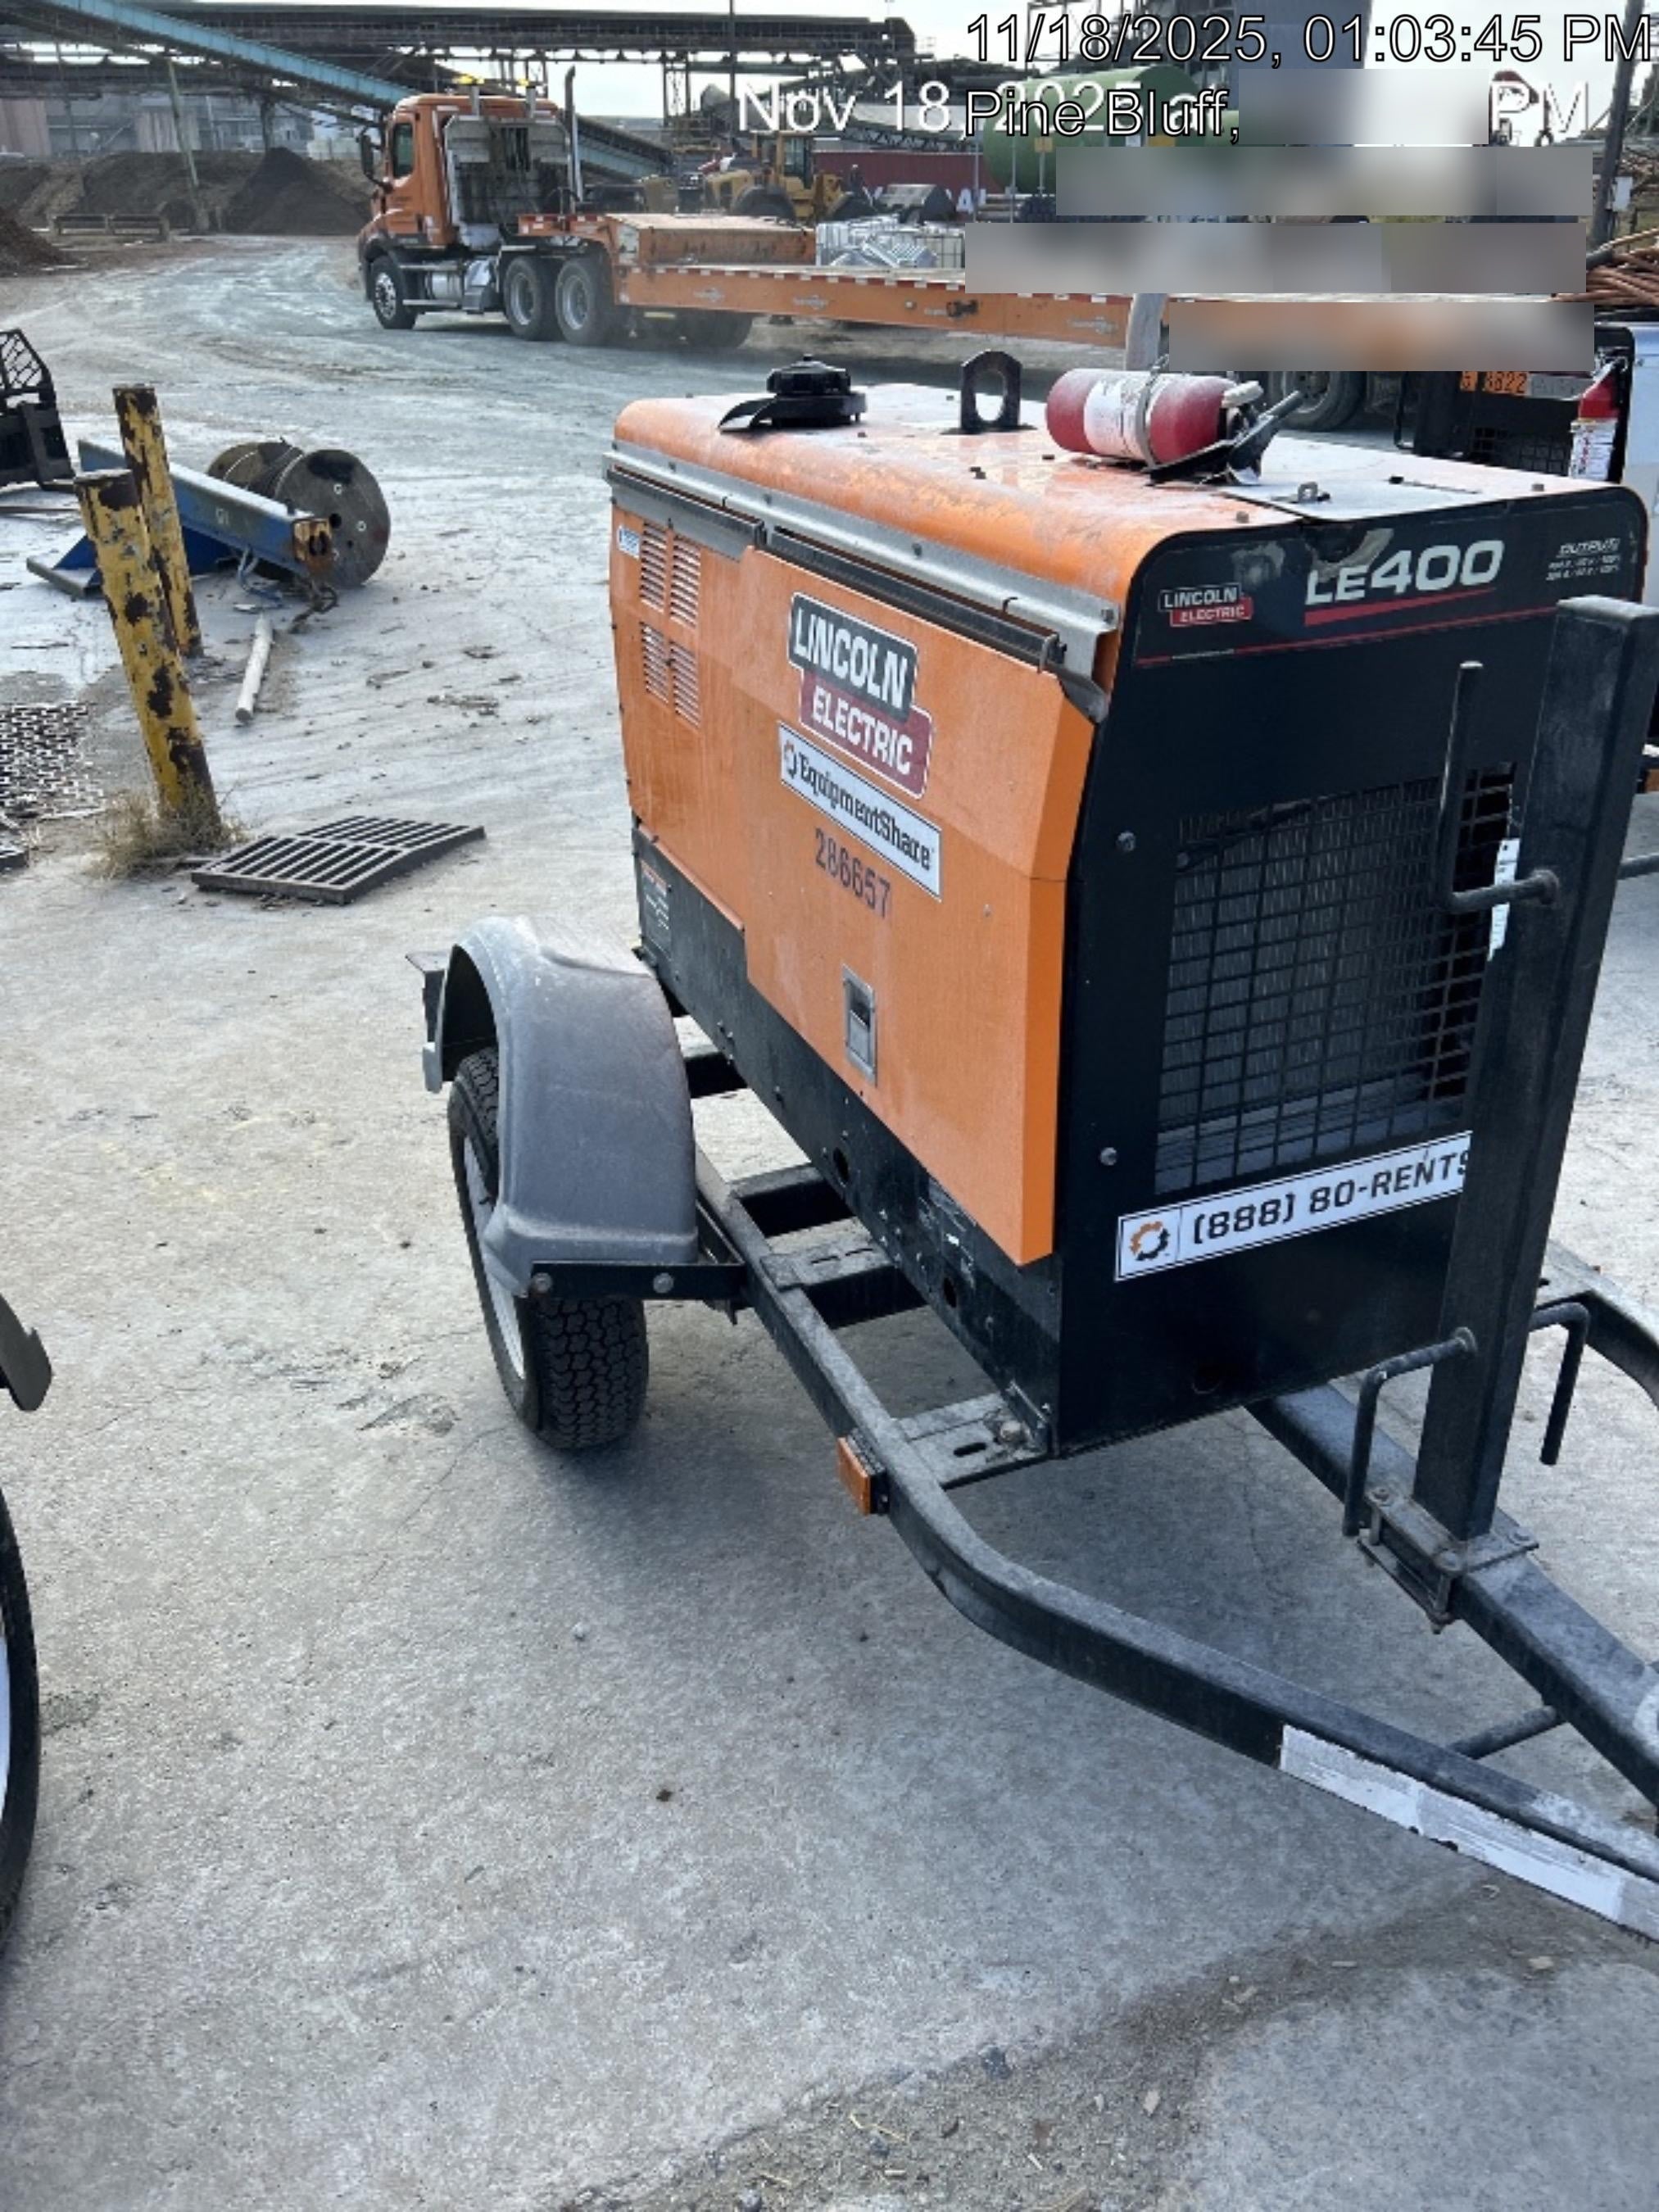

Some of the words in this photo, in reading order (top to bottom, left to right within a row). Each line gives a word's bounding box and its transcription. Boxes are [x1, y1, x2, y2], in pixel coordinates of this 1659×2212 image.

[1163, 586, 1239, 609] LINCOLN
[1304, 539, 1506, 606] LE400
[1179, 605, 1246, 624] ELECTRIC
[793, 608, 909, 709] LINCOLN
[812, 684, 913, 777] ELECTRIC
[799, 752, 931, 872] EquipmentShare
[814, 827, 892, 918] 286657
[1193, 1193, 1294, 1245] (888)
